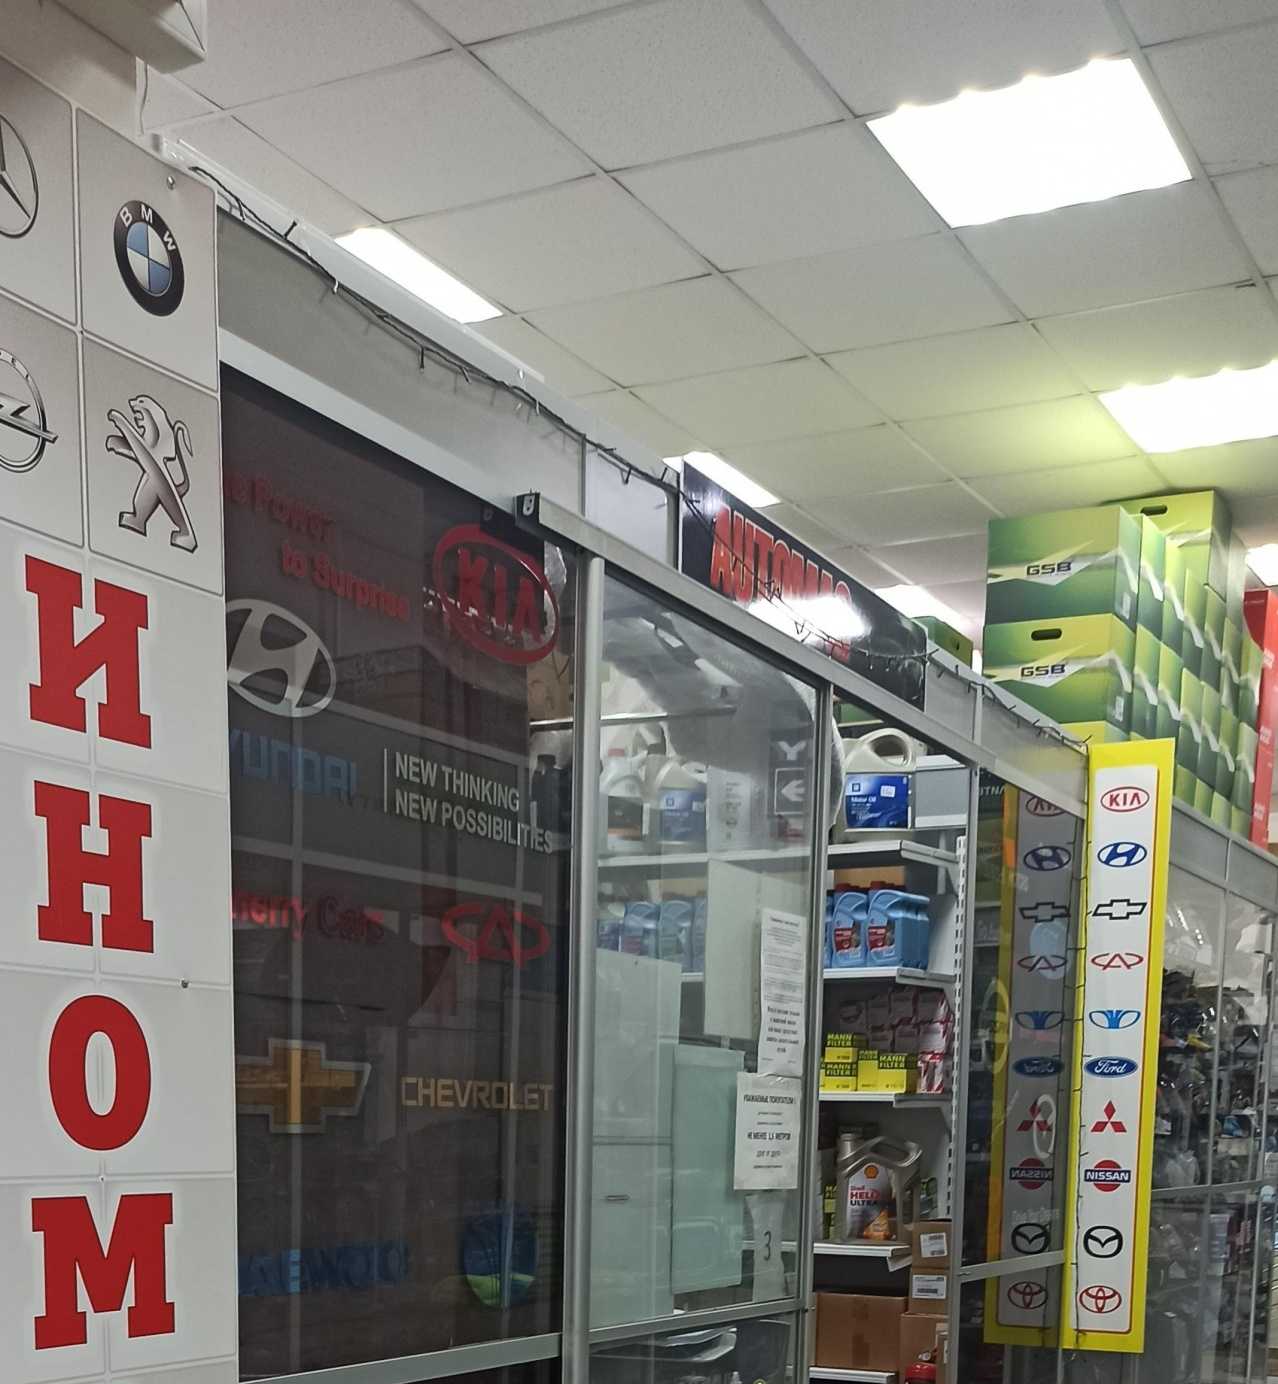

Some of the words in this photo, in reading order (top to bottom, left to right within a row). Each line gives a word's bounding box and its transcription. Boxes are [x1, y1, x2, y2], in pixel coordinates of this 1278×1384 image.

[119, 204, 178, 252] BMW
[1026, 561, 1073, 577] GSB
[457, 547, 543, 642] KIA
[1020, 663, 1066, 678] GSB
[394, 751, 438, 788] NEW
[441, 764, 521, 813] THINKING
[1109, 792, 1142, 808] KIA
[394, 787, 438, 825] NEW
[441, 802, 554, 855] POSSIBILITIES
[1094, 1059, 1127, 1074] Ford
[401, 1077, 553, 1112] CHEVROLET
[1086, 1171, 1129, 1182] NISSAN
